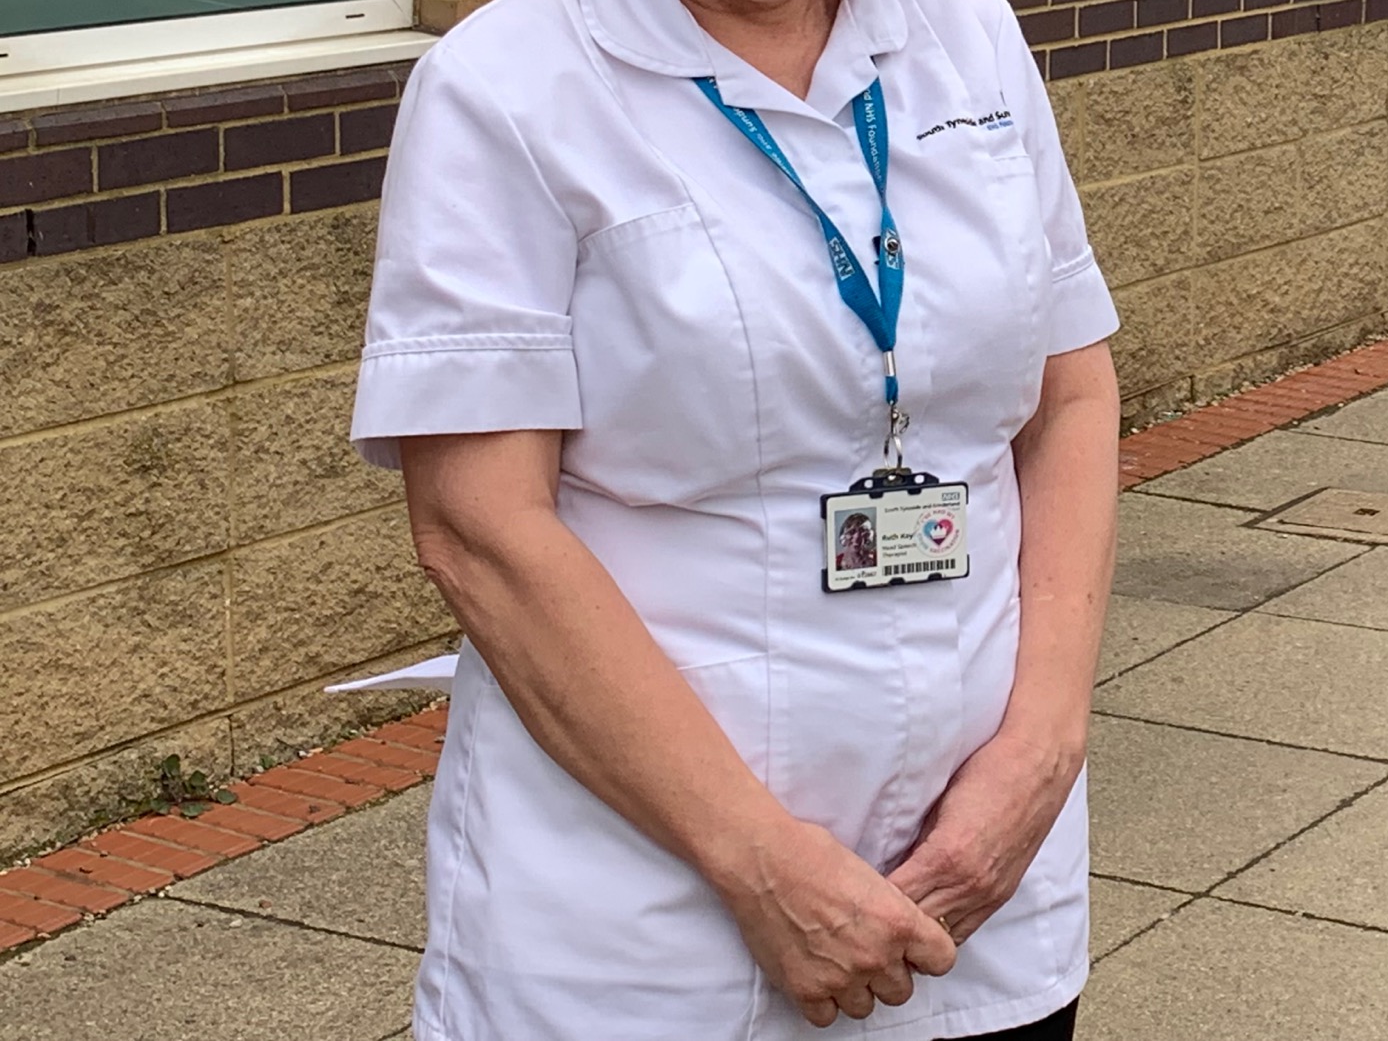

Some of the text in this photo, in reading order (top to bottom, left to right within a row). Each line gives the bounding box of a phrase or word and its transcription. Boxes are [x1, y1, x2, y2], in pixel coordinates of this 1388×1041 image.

[864, 102, 876, 123] NHS
[978, 113, 995, 125] and
[829, 236, 855, 281] NHS
